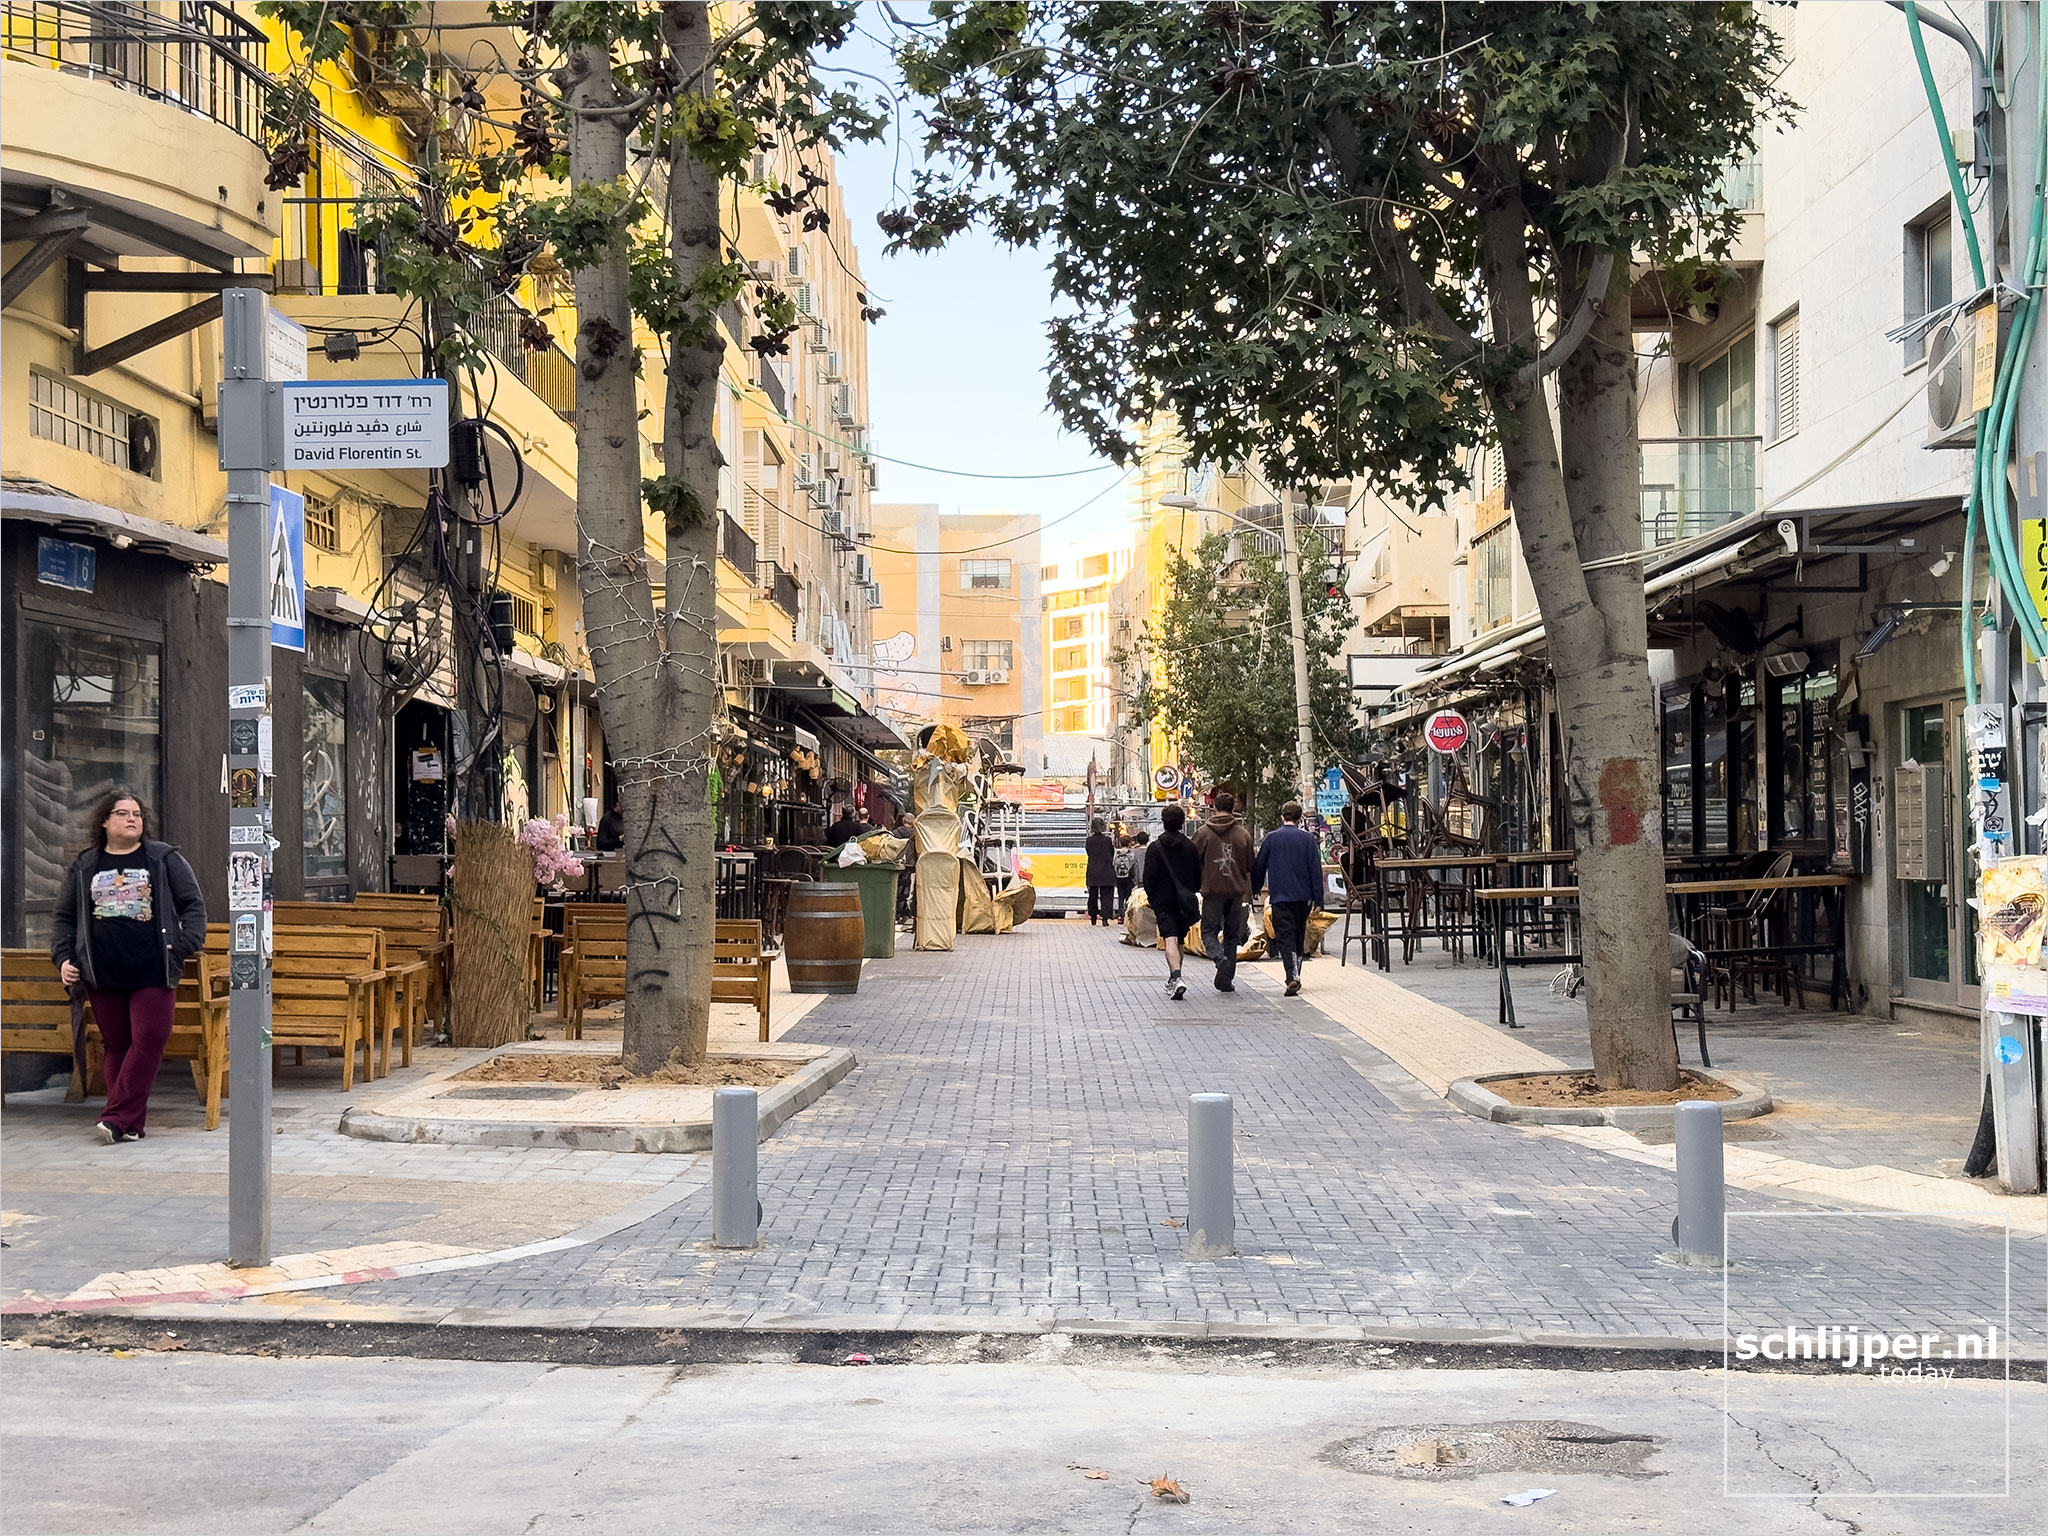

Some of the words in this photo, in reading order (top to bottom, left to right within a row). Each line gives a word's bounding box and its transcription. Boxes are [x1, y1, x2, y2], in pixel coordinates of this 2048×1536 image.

[294, 393, 369, 414] פלורנטין
[373, 395, 402, 408] דוד
[407, 394, 432, 408] רח'
[294, 421, 353, 438] فلورنتين
[395, 419, 422, 437] شارع
[294, 446, 335, 461] David
[339, 446, 402, 460] Florentin
[406, 448, 422, 460] St.
[82, 556, 89, 582] 6
